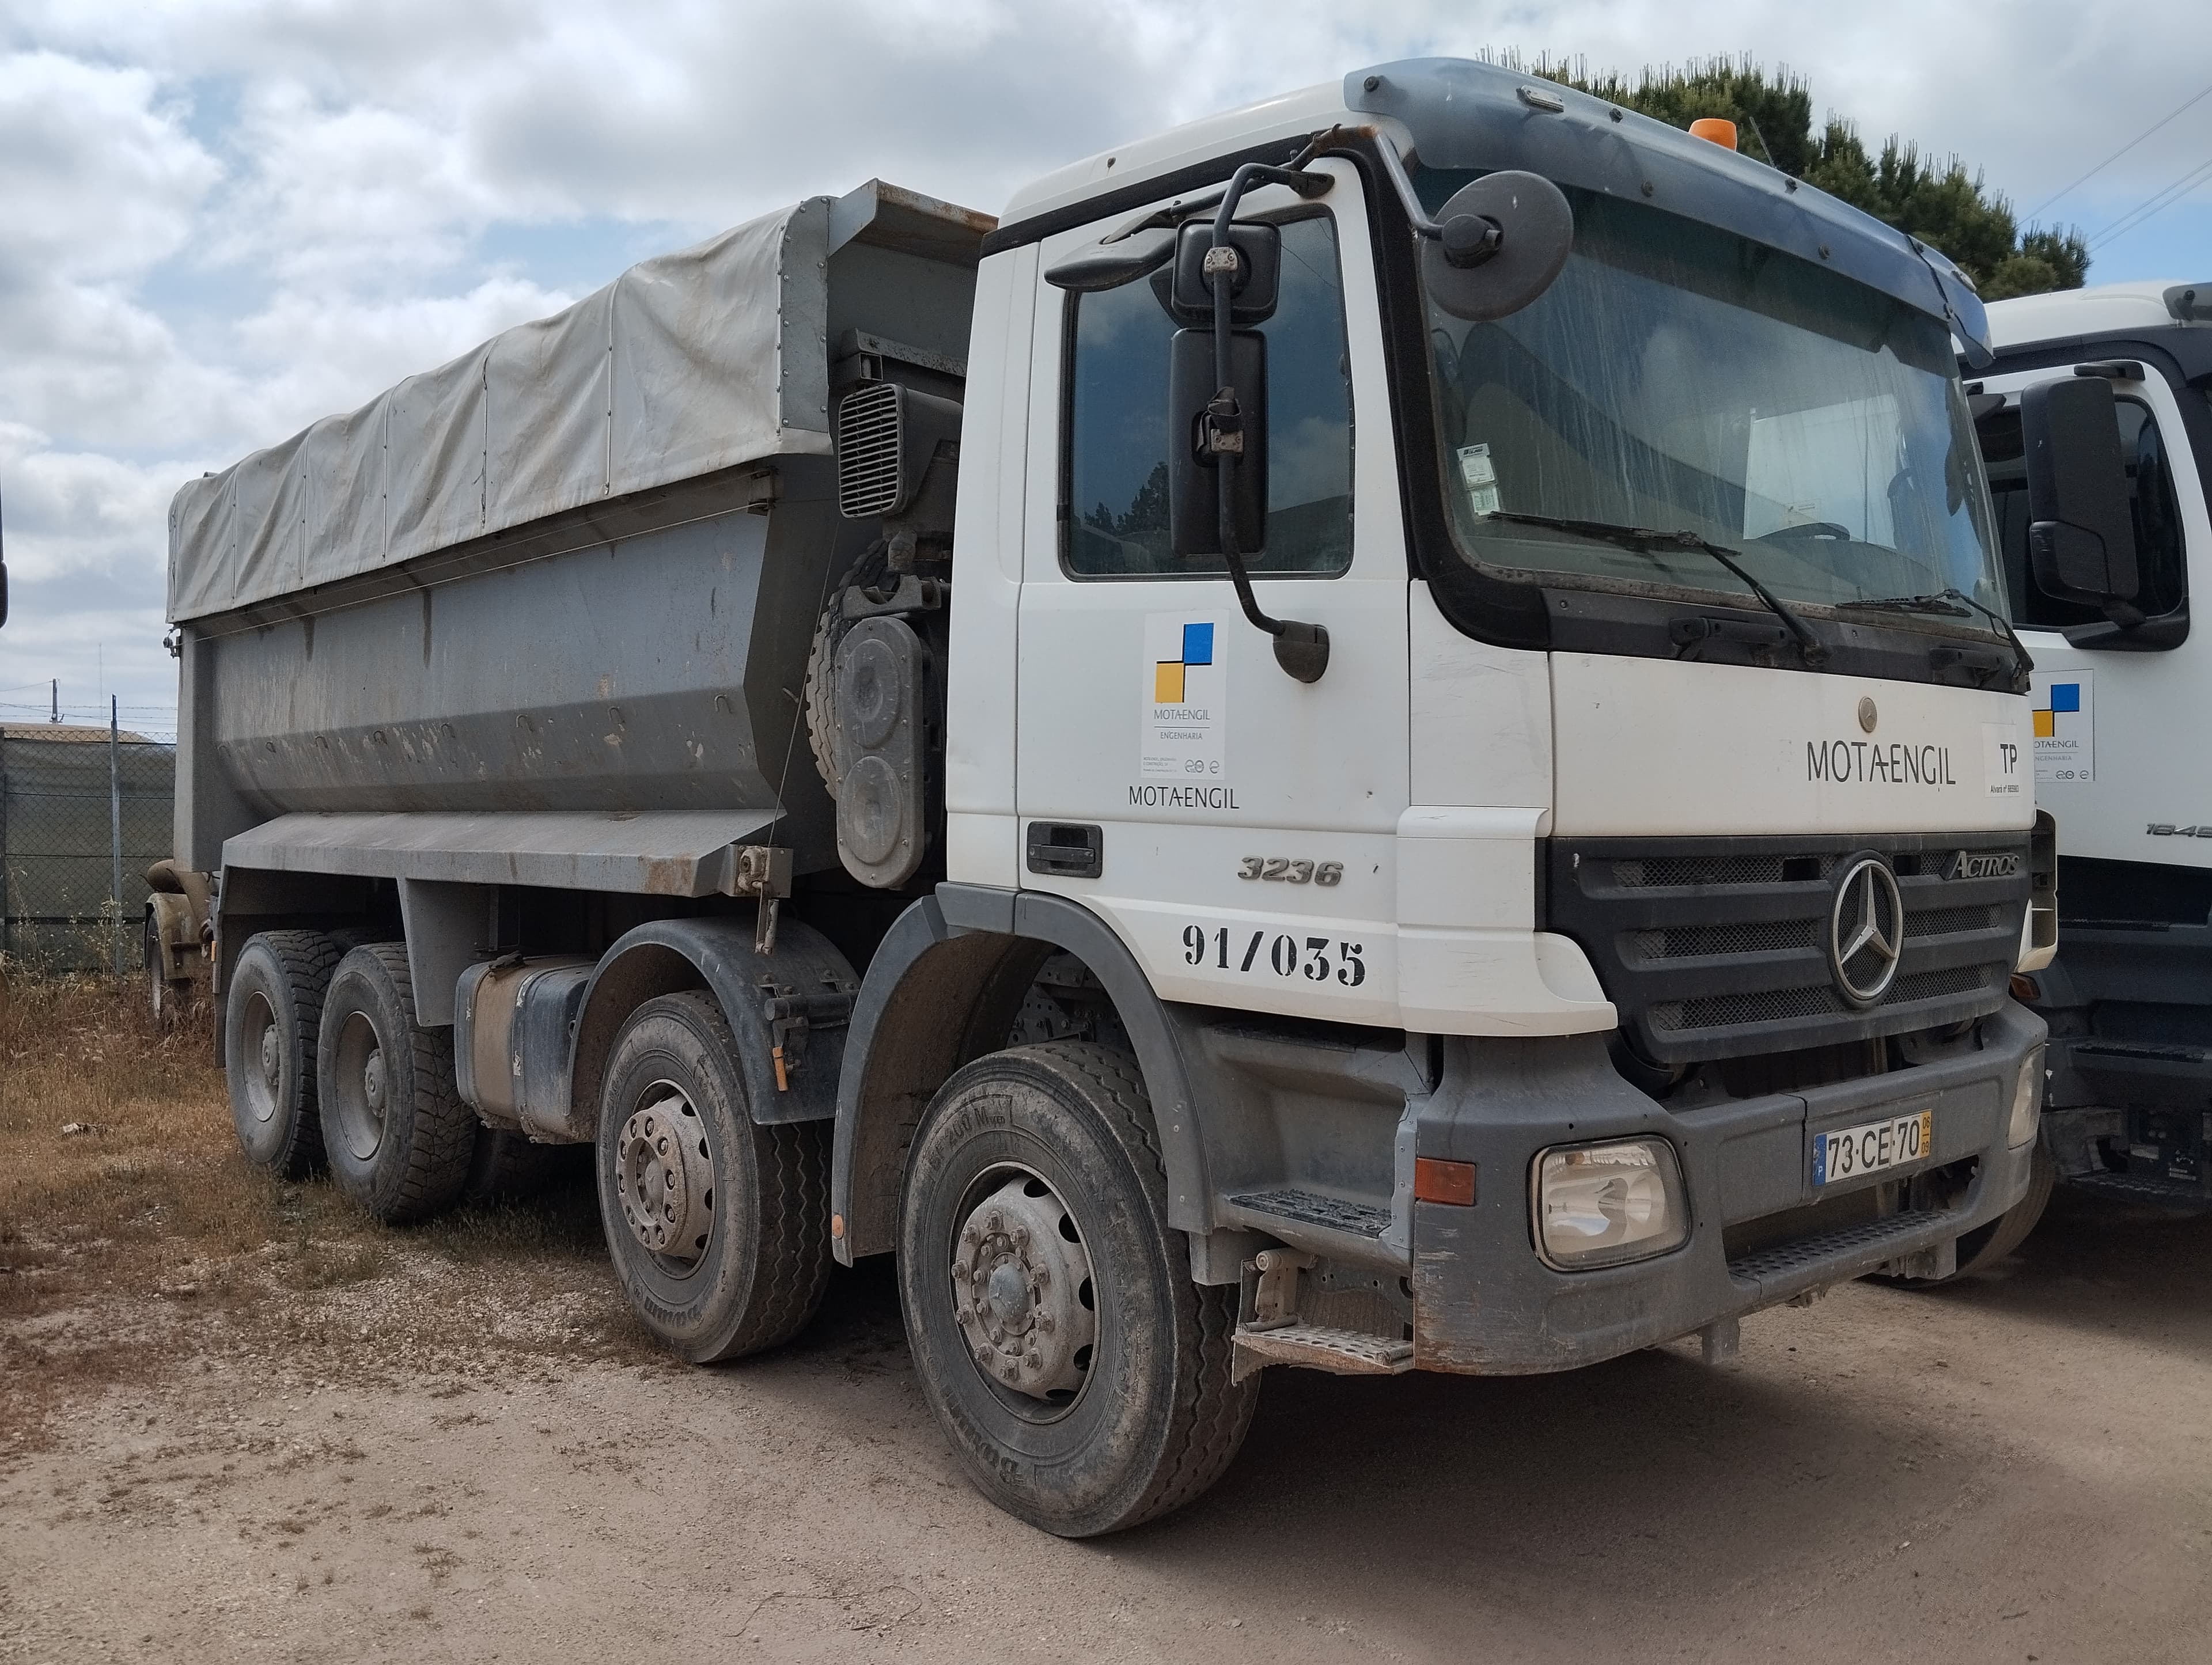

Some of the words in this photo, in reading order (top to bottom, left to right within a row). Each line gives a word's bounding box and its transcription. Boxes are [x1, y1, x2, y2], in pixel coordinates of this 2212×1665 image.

[1160, 731, 1203, 740] ENGENHARIA
[1999, 743, 2017, 774] TP
[1237, 855, 1344, 886] 3236
[1183, 925, 1366, 987] 91/035
[1817, 1166, 1823, 1176] P
